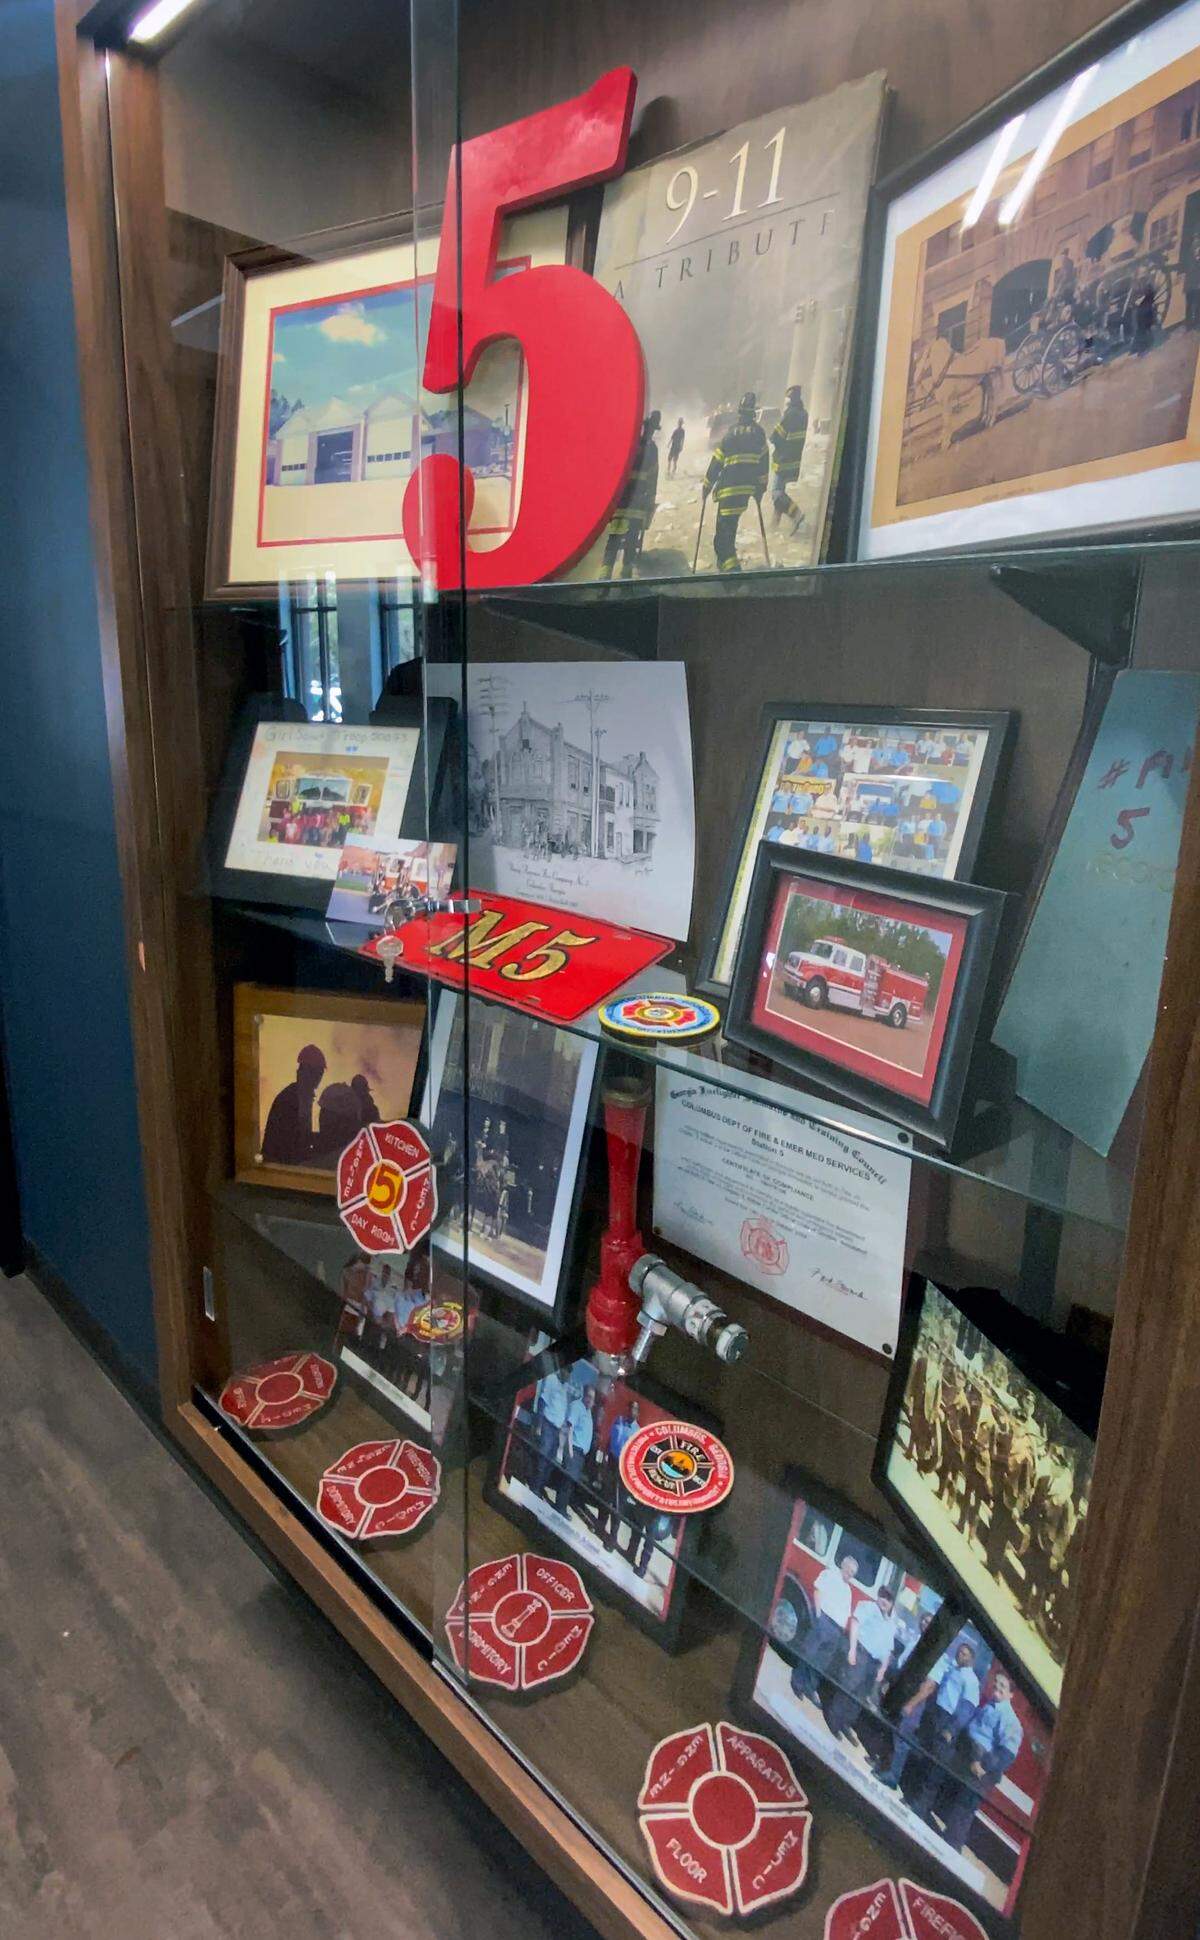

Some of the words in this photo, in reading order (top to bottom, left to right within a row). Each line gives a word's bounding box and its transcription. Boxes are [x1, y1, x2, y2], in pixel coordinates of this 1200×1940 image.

[665, 127, 787, 245] 9-11
[613, 280, 625, 299] A
[402, 65, 644, 589] 5
[1110, 807, 1151, 849] 5
[426, 908, 600, 981] M5
[384, 1132, 420, 1158] KITCHEN
[681, 1099, 721, 1121] COLUMBUS
[722, 1115, 741, 1130] DEPT
[742, 1126, 754, 1136] OF
[754, 1129, 771, 1143] FIRE
[773, 1137, 780, 1145] &
[781, 1139, 805, 1155] EMER
[805, 1149, 826, 1163] MED
[826, 1156, 871, 1181] SERVICES
[343, 1139, 364, 1198] ENGINE
[371, 1164, 403, 1209] 5
[410, 1177, 431, 1231] MEDIC
[351, 1213, 369, 1230] DAY
[370, 1224, 395, 1246] ROOM
[680, 1440, 706, 1462] FIRE
[375, 1500, 426, 1531] MEDIC
[536, 1567, 576, 1603] OFFICER
[537, 1625, 583, 1671] MEDIC
[650, 1735, 704, 1799] ENGINE
[726, 1735, 798, 1799] APPARATUS
[666, 1837, 708, 1884] FLOOR
[752, 1829, 799, 1890] MEDIC
